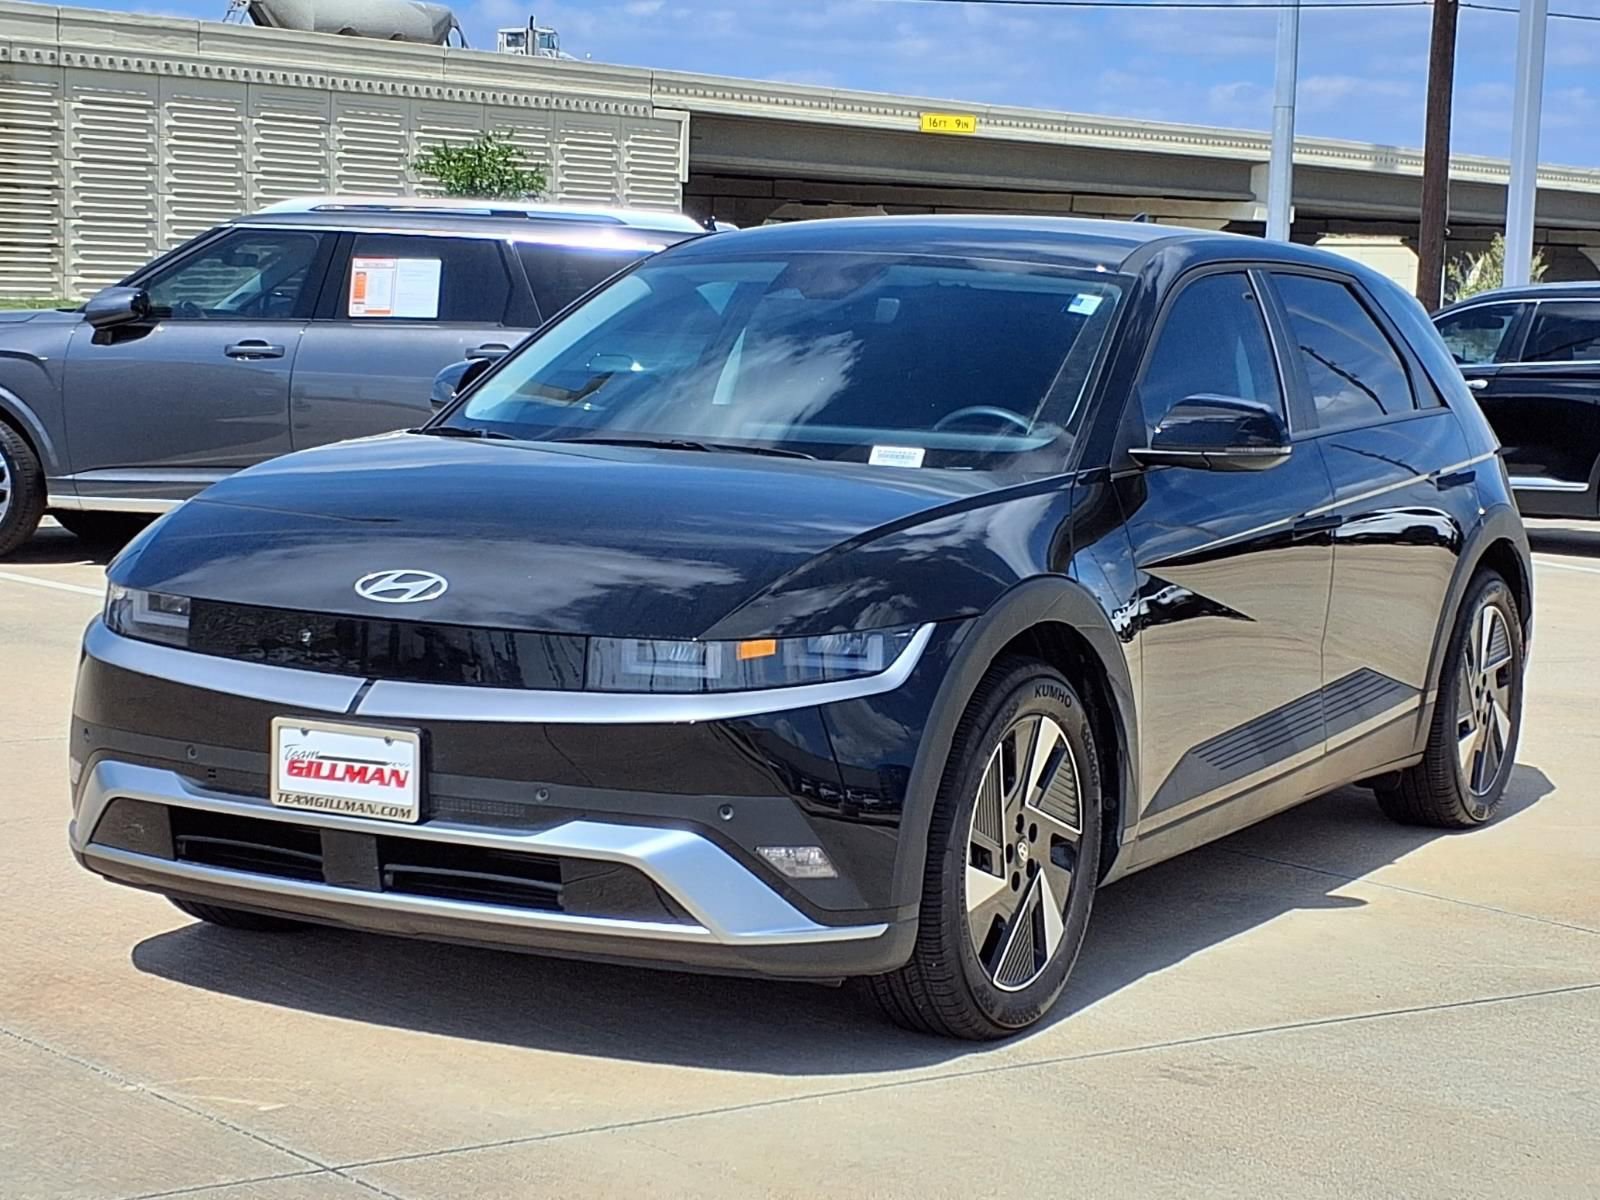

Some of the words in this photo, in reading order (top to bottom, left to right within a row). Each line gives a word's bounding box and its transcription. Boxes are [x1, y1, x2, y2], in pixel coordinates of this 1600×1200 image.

[1034, 684, 1072, 708] KUMHO
[284, 743, 320, 761] Team
[287, 758, 409, 789] GILLMAN
[277, 792, 412, 820] TEAMGILLMAN.COM
